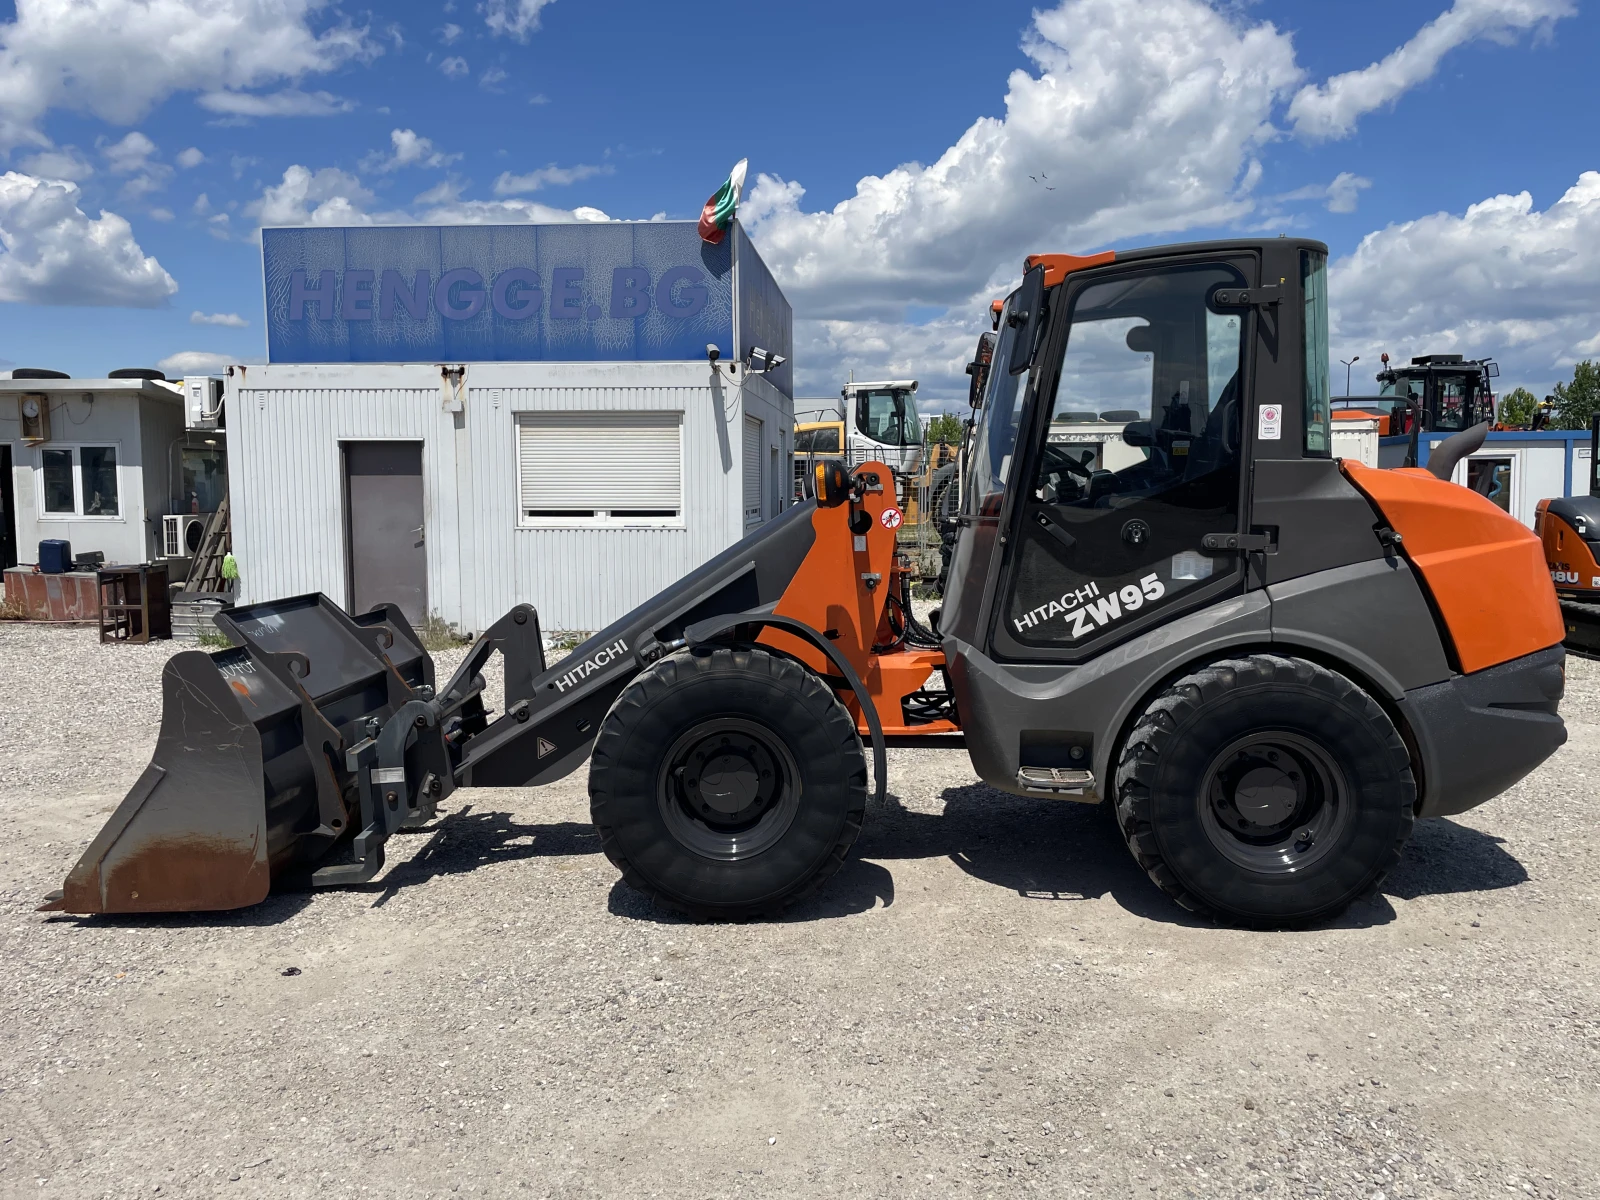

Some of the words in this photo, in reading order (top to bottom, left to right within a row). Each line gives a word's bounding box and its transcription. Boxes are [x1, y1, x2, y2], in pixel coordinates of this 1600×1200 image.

[289, 267, 709, 320] HENGGE.BG
[1013, 581, 1101, 633] HITACHI
[1065, 572, 1165, 638] ZW95
[556, 639, 629, 692] HITACHI
